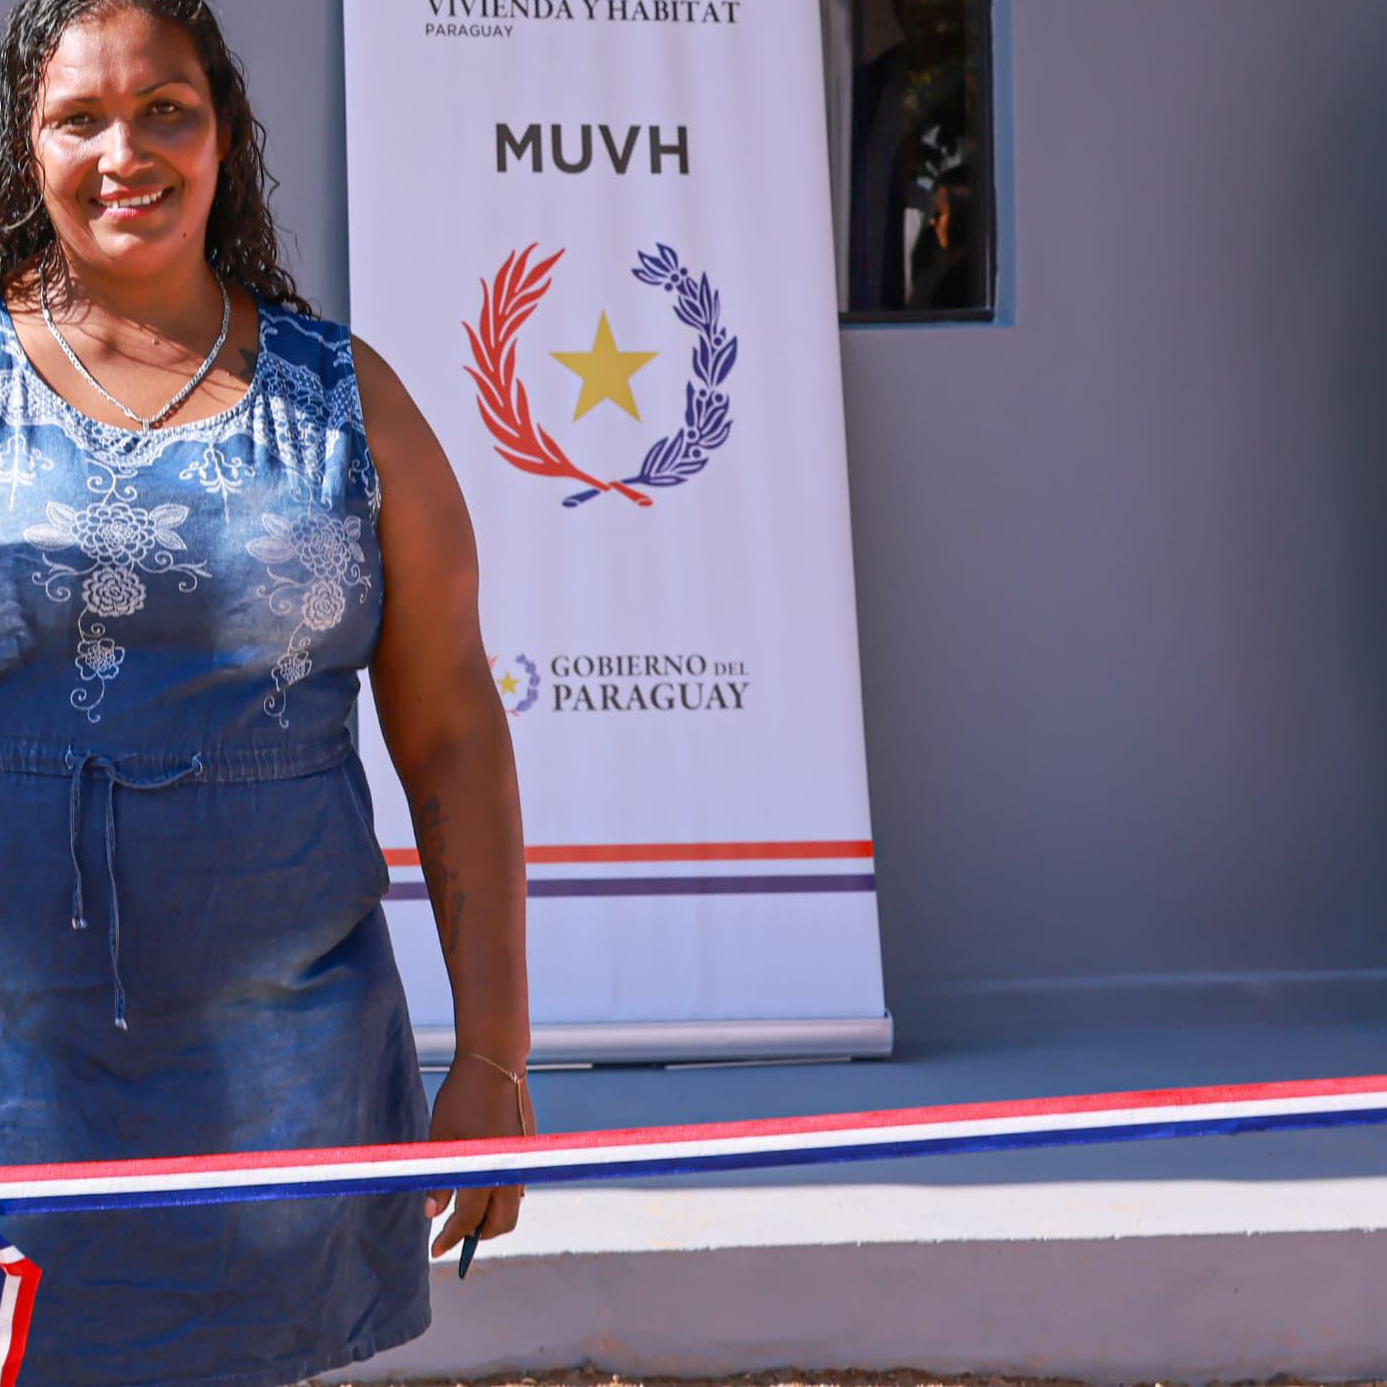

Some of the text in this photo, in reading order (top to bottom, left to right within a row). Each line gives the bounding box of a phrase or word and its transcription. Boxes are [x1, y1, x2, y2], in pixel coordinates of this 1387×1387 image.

[425, 23, 514, 38] PARAGUAY
[495, 122, 690, 175] MUVH
[551, 654, 750, 678] GOBIERNO DEL
[552, 682, 751, 712] PARAGUAY
